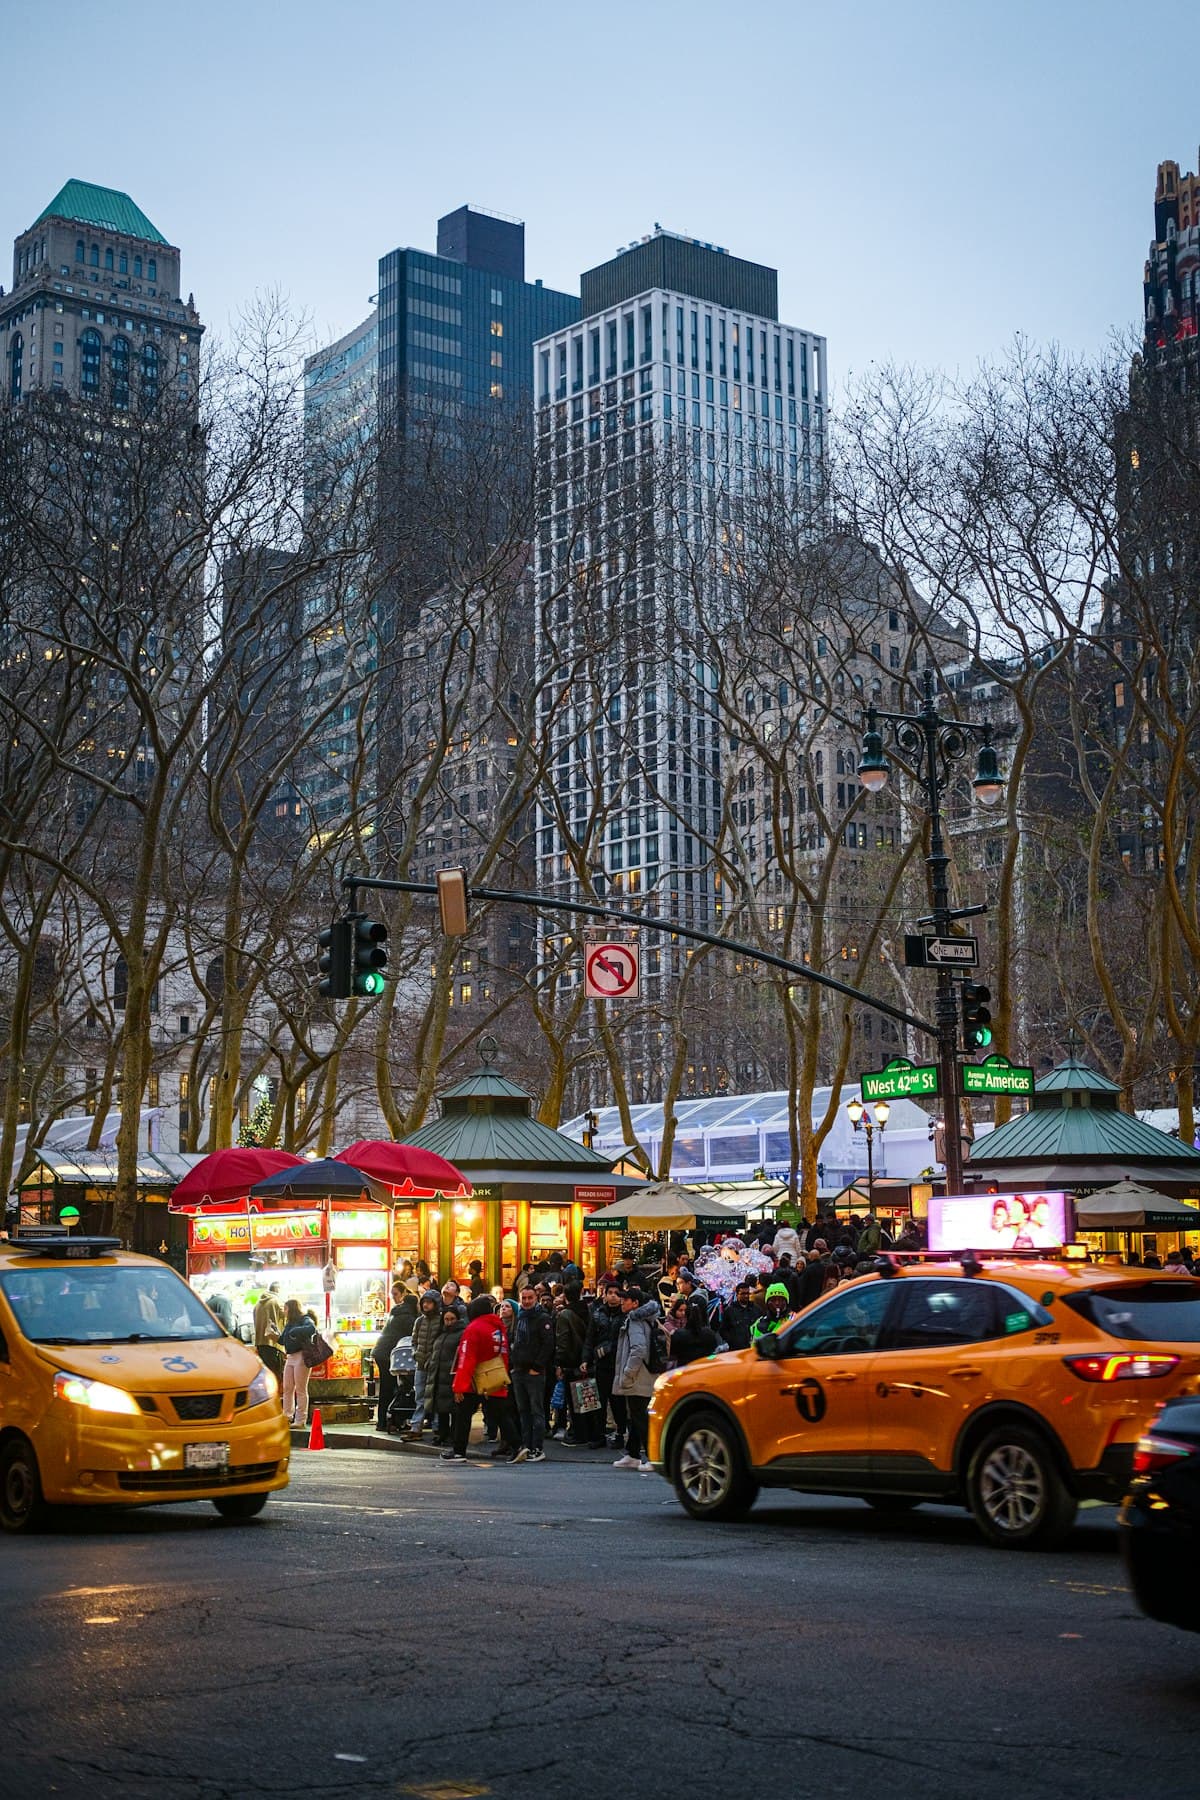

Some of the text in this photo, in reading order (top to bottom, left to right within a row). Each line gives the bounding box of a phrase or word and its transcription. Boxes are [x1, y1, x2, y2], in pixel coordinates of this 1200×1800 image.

[934, 946, 969, 957] ONE WAY
[968, 1071, 985, 1079] Avenue
[985, 1072, 1030, 1089] Americas
[867, 1073, 934, 1095] West 42nd St
[968, 1079, 974, 1087] of
[472, 1188, 492, 1196] ARK
[255, 1224, 288, 1237] SPOT
[800, 1386, 818, 1417] T
